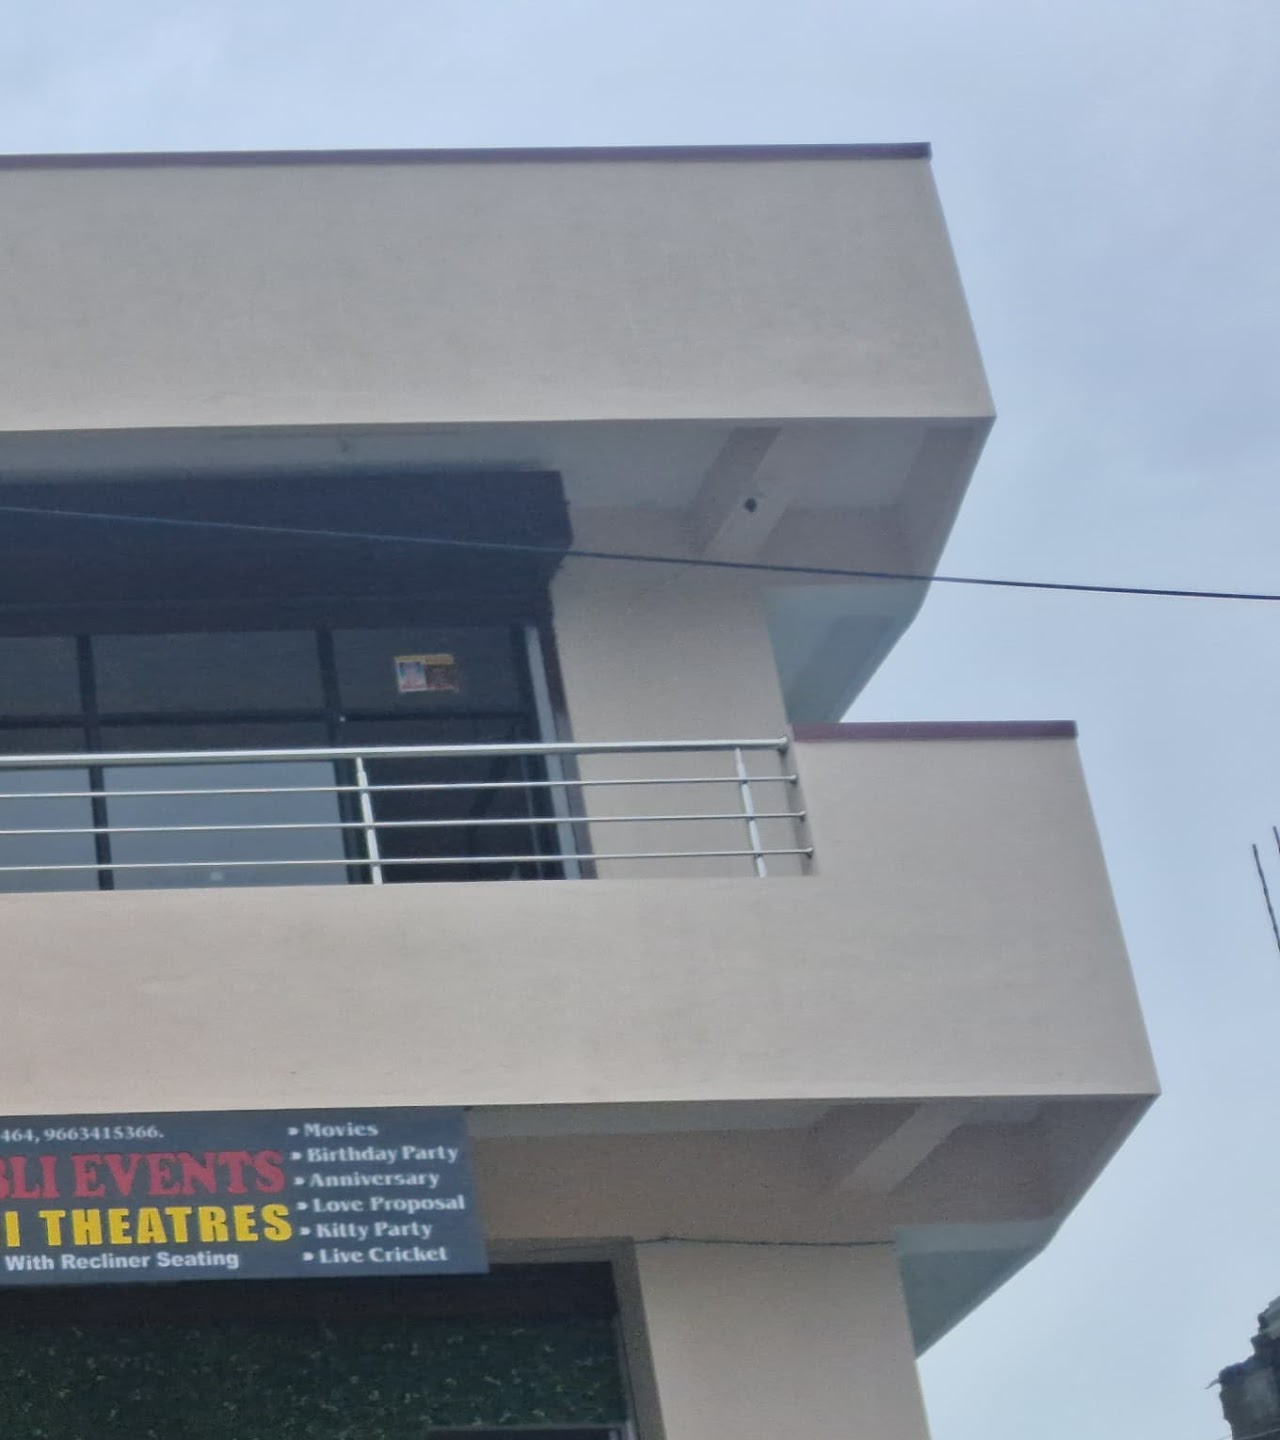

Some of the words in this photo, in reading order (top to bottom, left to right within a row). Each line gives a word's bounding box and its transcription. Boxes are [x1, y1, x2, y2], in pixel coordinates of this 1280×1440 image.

[303, 1122, 379, 1138] Movies
[307, 1147, 396, 1164] Birthday
[402, 1145, 459, 1163] Party
[70, 1150, 286, 1198] EVENTS
[309, 1172, 440, 1189] Anniversary
[312, 1198, 364, 1213] Love
[370, 1195, 466, 1214] Proposal
[38, 1204, 292, 1247] THEATRES
[316, 1223, 369, 1241] Kitty
[374, 1222, 433, 1239] Party
[5, 1254, 54, 1271] With
[61, 1253, 151, 1269] Recliner
[155, 1251, 240, 1269] Seating
[319, 1248, 364, 1264] Live
[369, 1246, 448, 1263] Cricket
